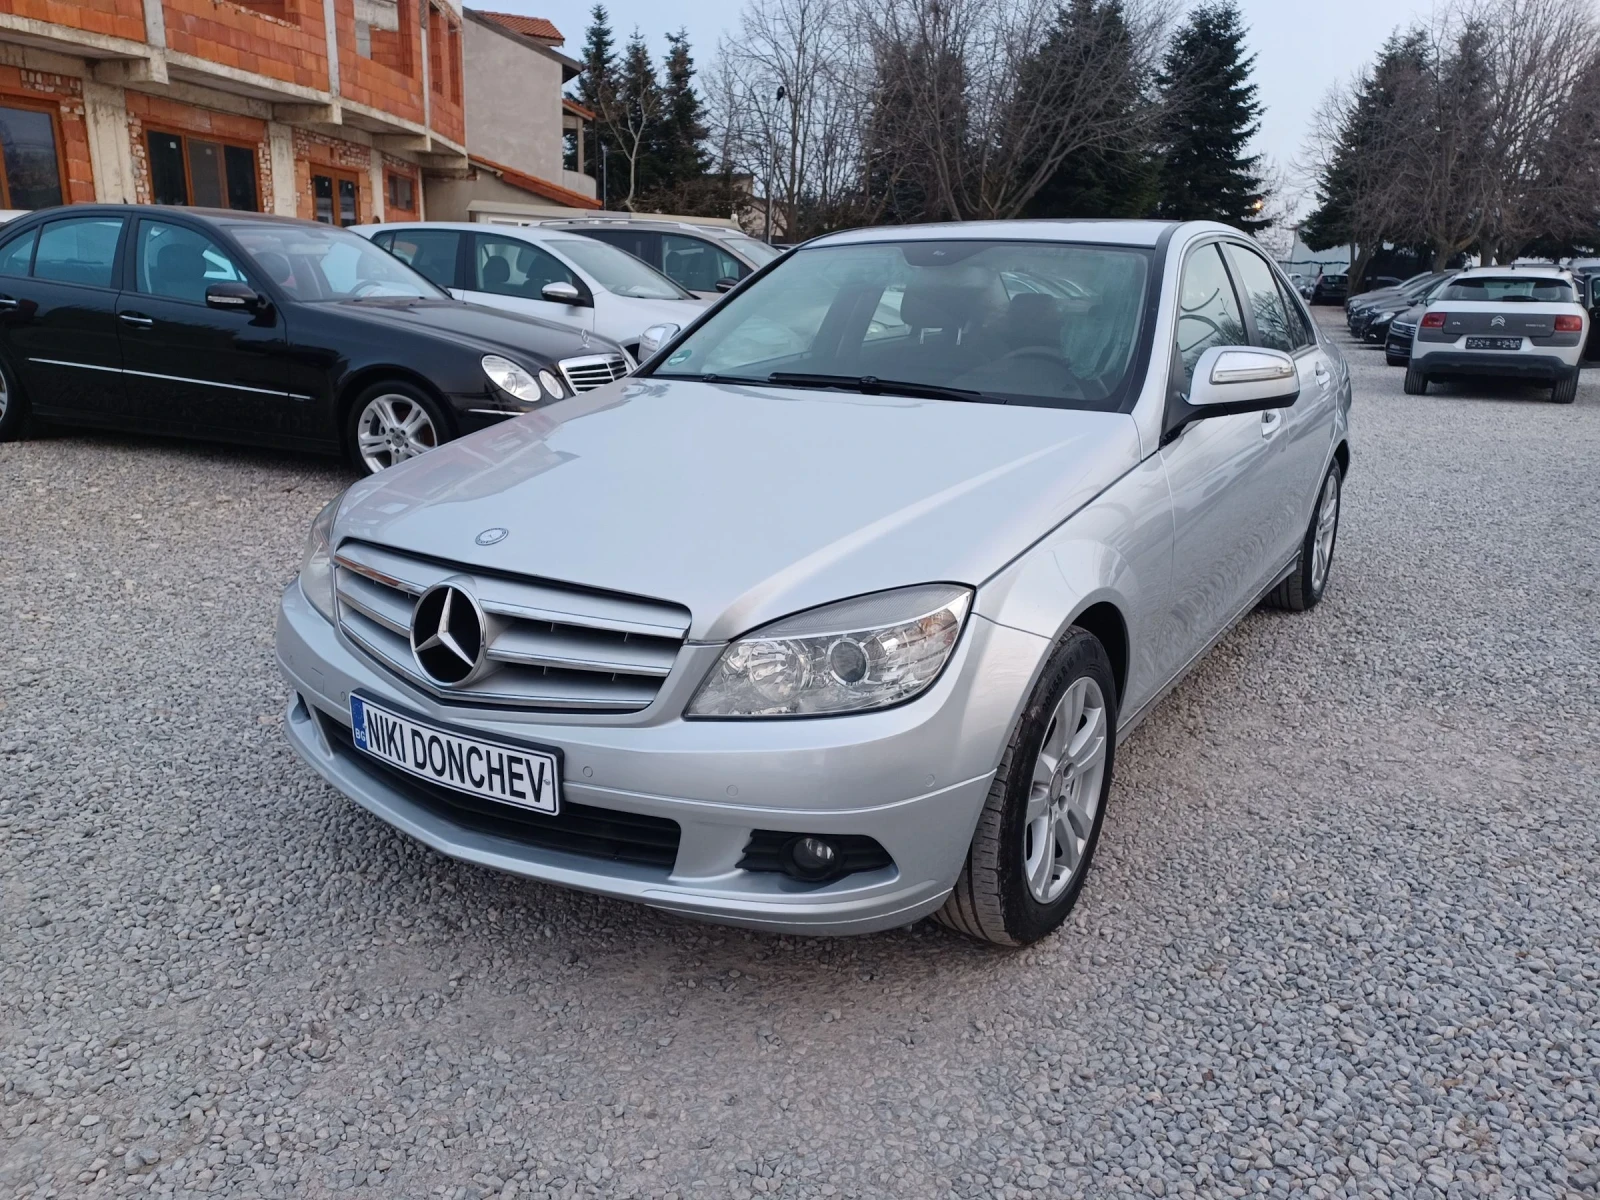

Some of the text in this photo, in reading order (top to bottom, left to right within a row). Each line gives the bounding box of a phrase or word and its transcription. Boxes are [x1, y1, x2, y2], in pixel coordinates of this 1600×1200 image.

[355, 727, 366, 742] BG
[366, 709, 546, 803] NIKI DONCHEV
